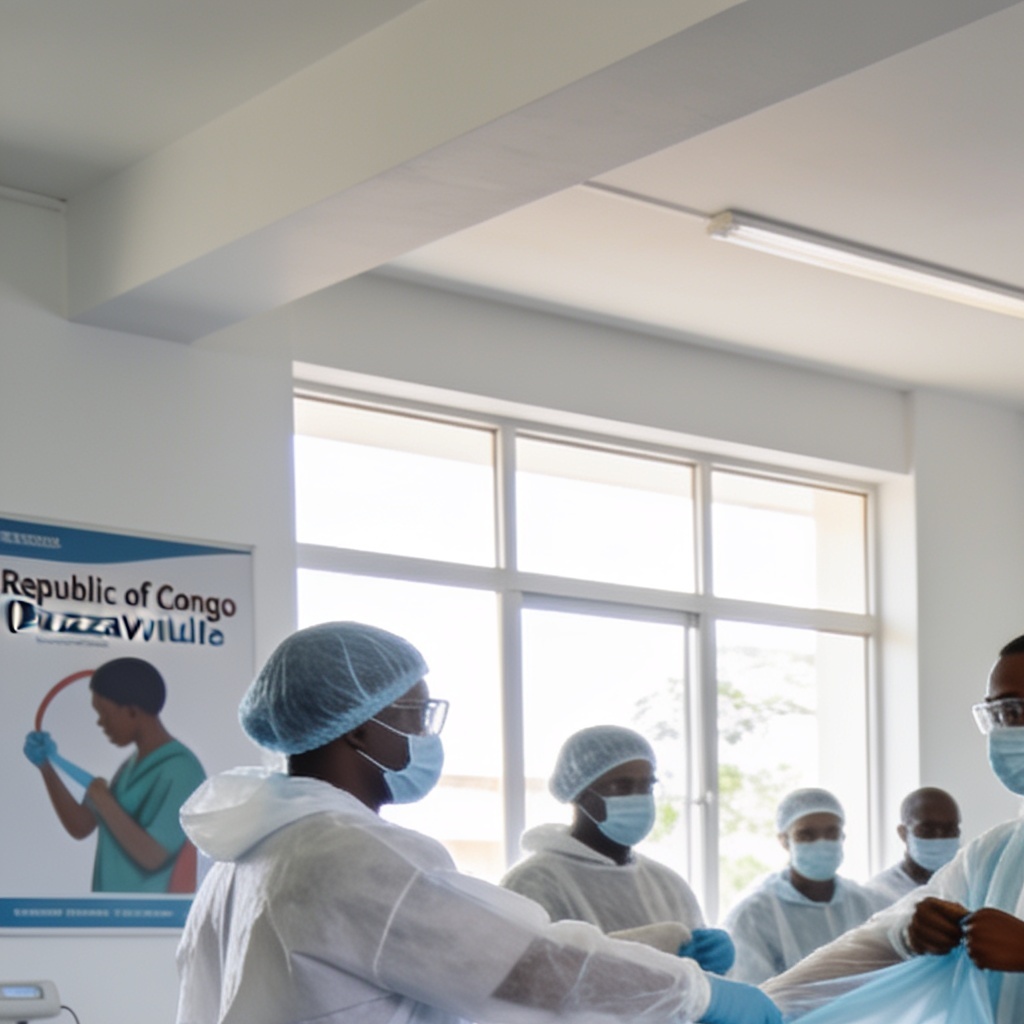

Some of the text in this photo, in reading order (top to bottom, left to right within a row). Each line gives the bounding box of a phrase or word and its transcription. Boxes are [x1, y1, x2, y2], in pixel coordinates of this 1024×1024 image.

[1, 568, 237, 623] Republic of Congo
